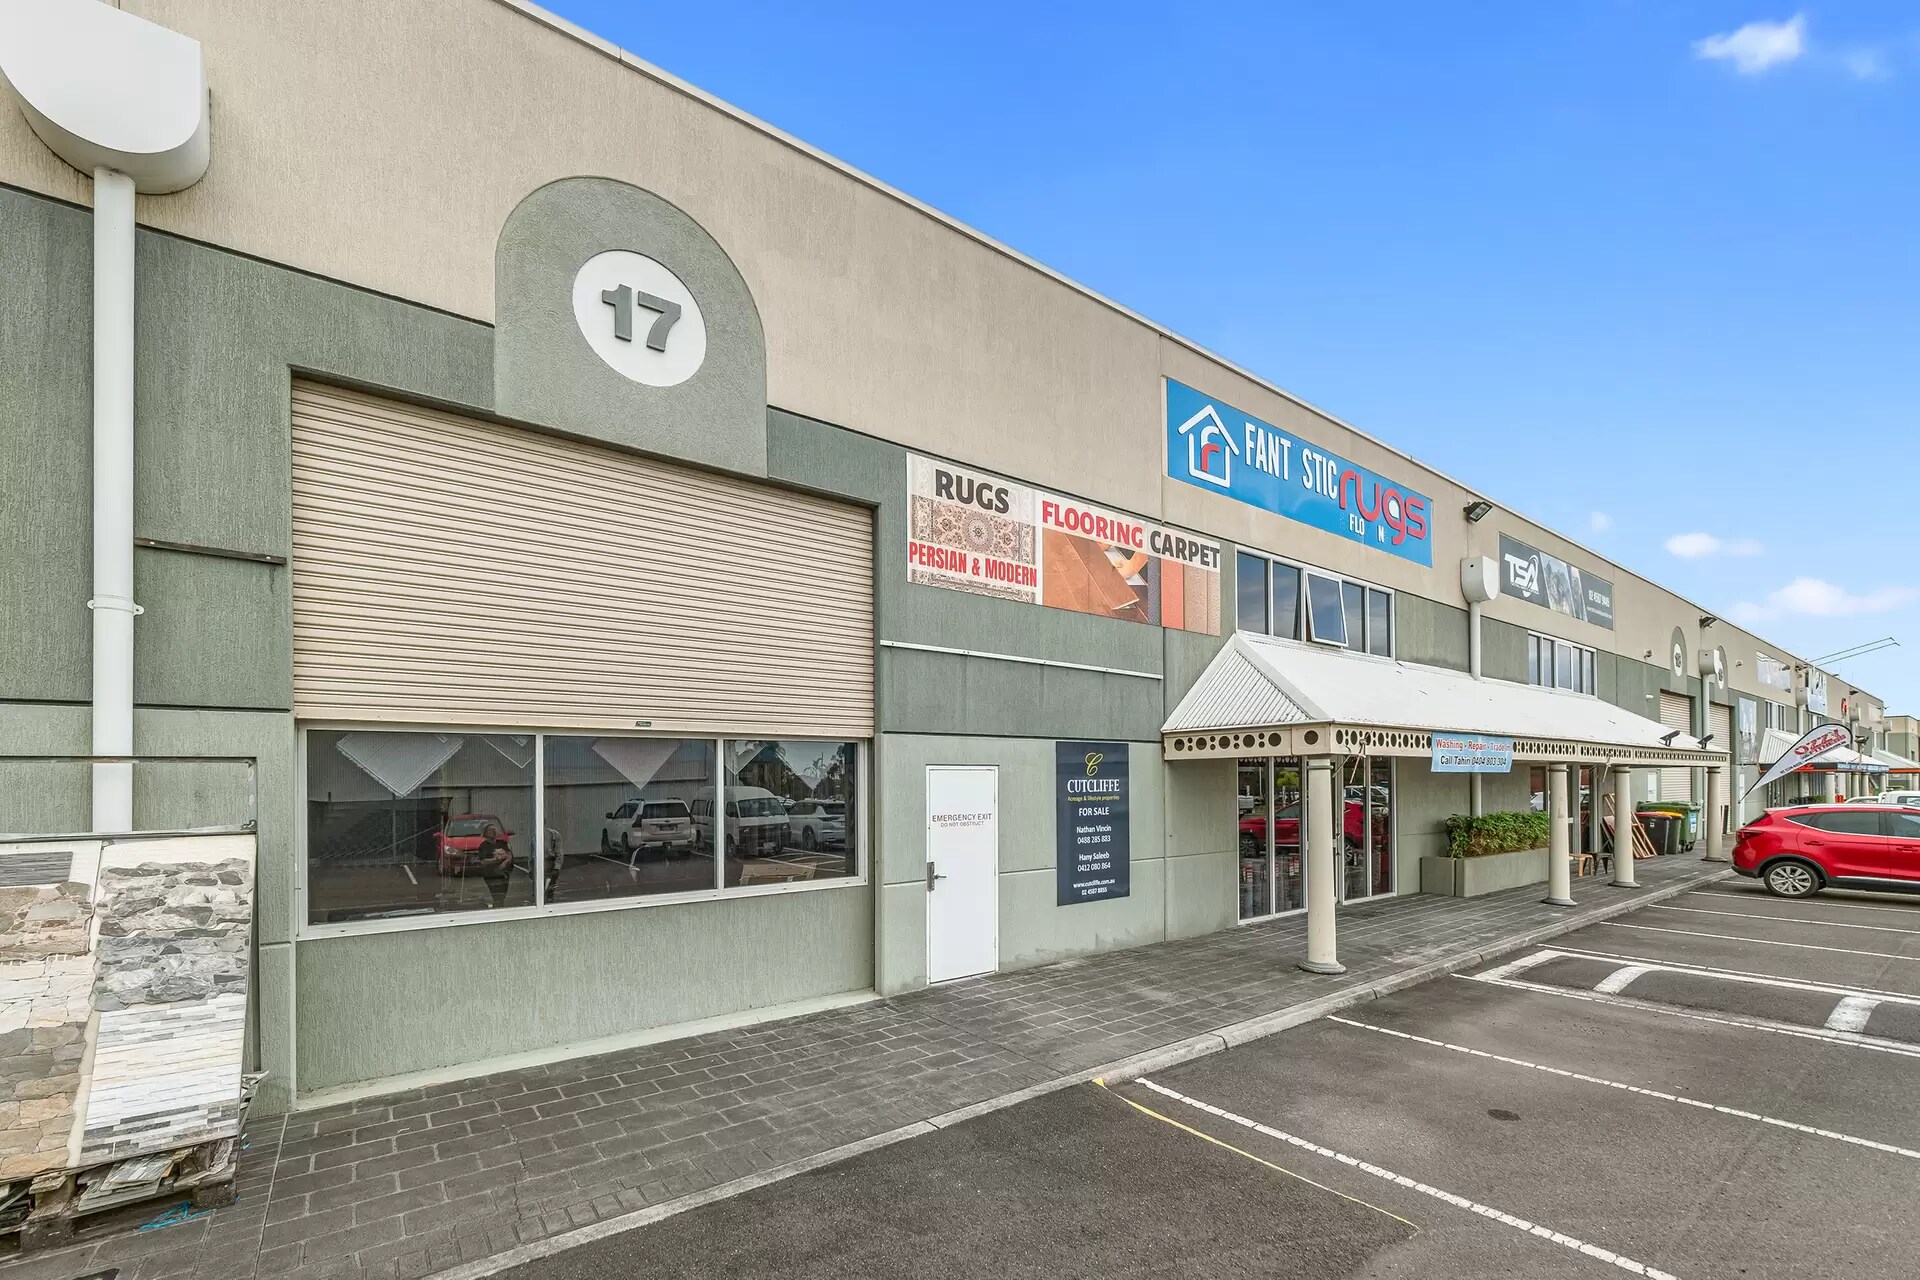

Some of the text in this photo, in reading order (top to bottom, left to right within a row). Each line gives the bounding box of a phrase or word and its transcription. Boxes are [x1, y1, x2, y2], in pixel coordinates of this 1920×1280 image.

[601, 284, 682, 352] 17
[1244, 421, 1427, 546] FANT STIC rugs
[935, 468, 1010, 514] RUGS
[1042, 500, 1143, 549] FLOORING
[1150, 530, 1221, 569] CARPET
[909, 541, 1037, 587] PERSIAN & MODERN
[1436, 739, 1463, 751] Washing
[1468, 741, 1486, 751] Repair
[1440, 755, 1453, 764] Call
[1067, 779, 1120, 793] CUTCLIFFE
[932, 813, 992, 822] EMERGENCY EXIT
[1078, 806, 1110, 817] FOR SALE
[1076, 826, 1095, 834] Nathan
[1077, 864, 1091, 872] 0412
